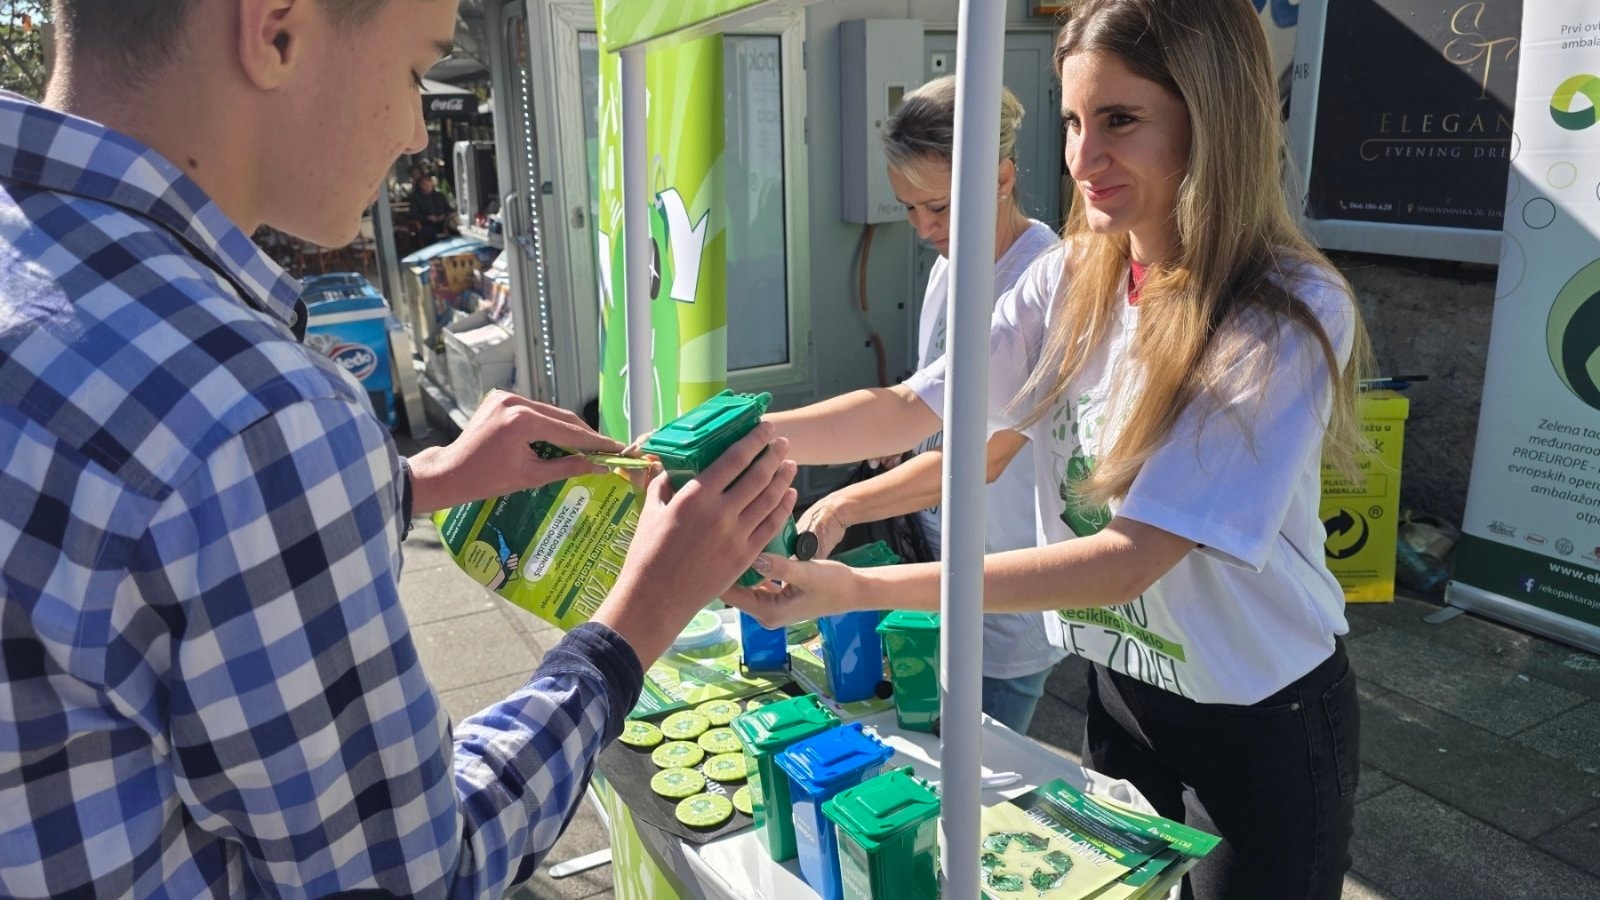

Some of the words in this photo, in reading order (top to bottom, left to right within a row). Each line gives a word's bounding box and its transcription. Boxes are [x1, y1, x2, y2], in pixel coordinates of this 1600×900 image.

[1561, 23, 1582, 35] Prvi
[1385, 146, 1461, 158] EVENING
[1538, 419, 1580, 436] Zelena
[1512, 446, 1589, 471] PROEUROPE
[1508, 463, 1566, 484] evropskih
[568, 505, 579, 518] TAJ
[555, 517, 573, 540] NAČIN
[589, 522, 617, 561] Recikliraj
[573, 561, 594, 588] staklo
